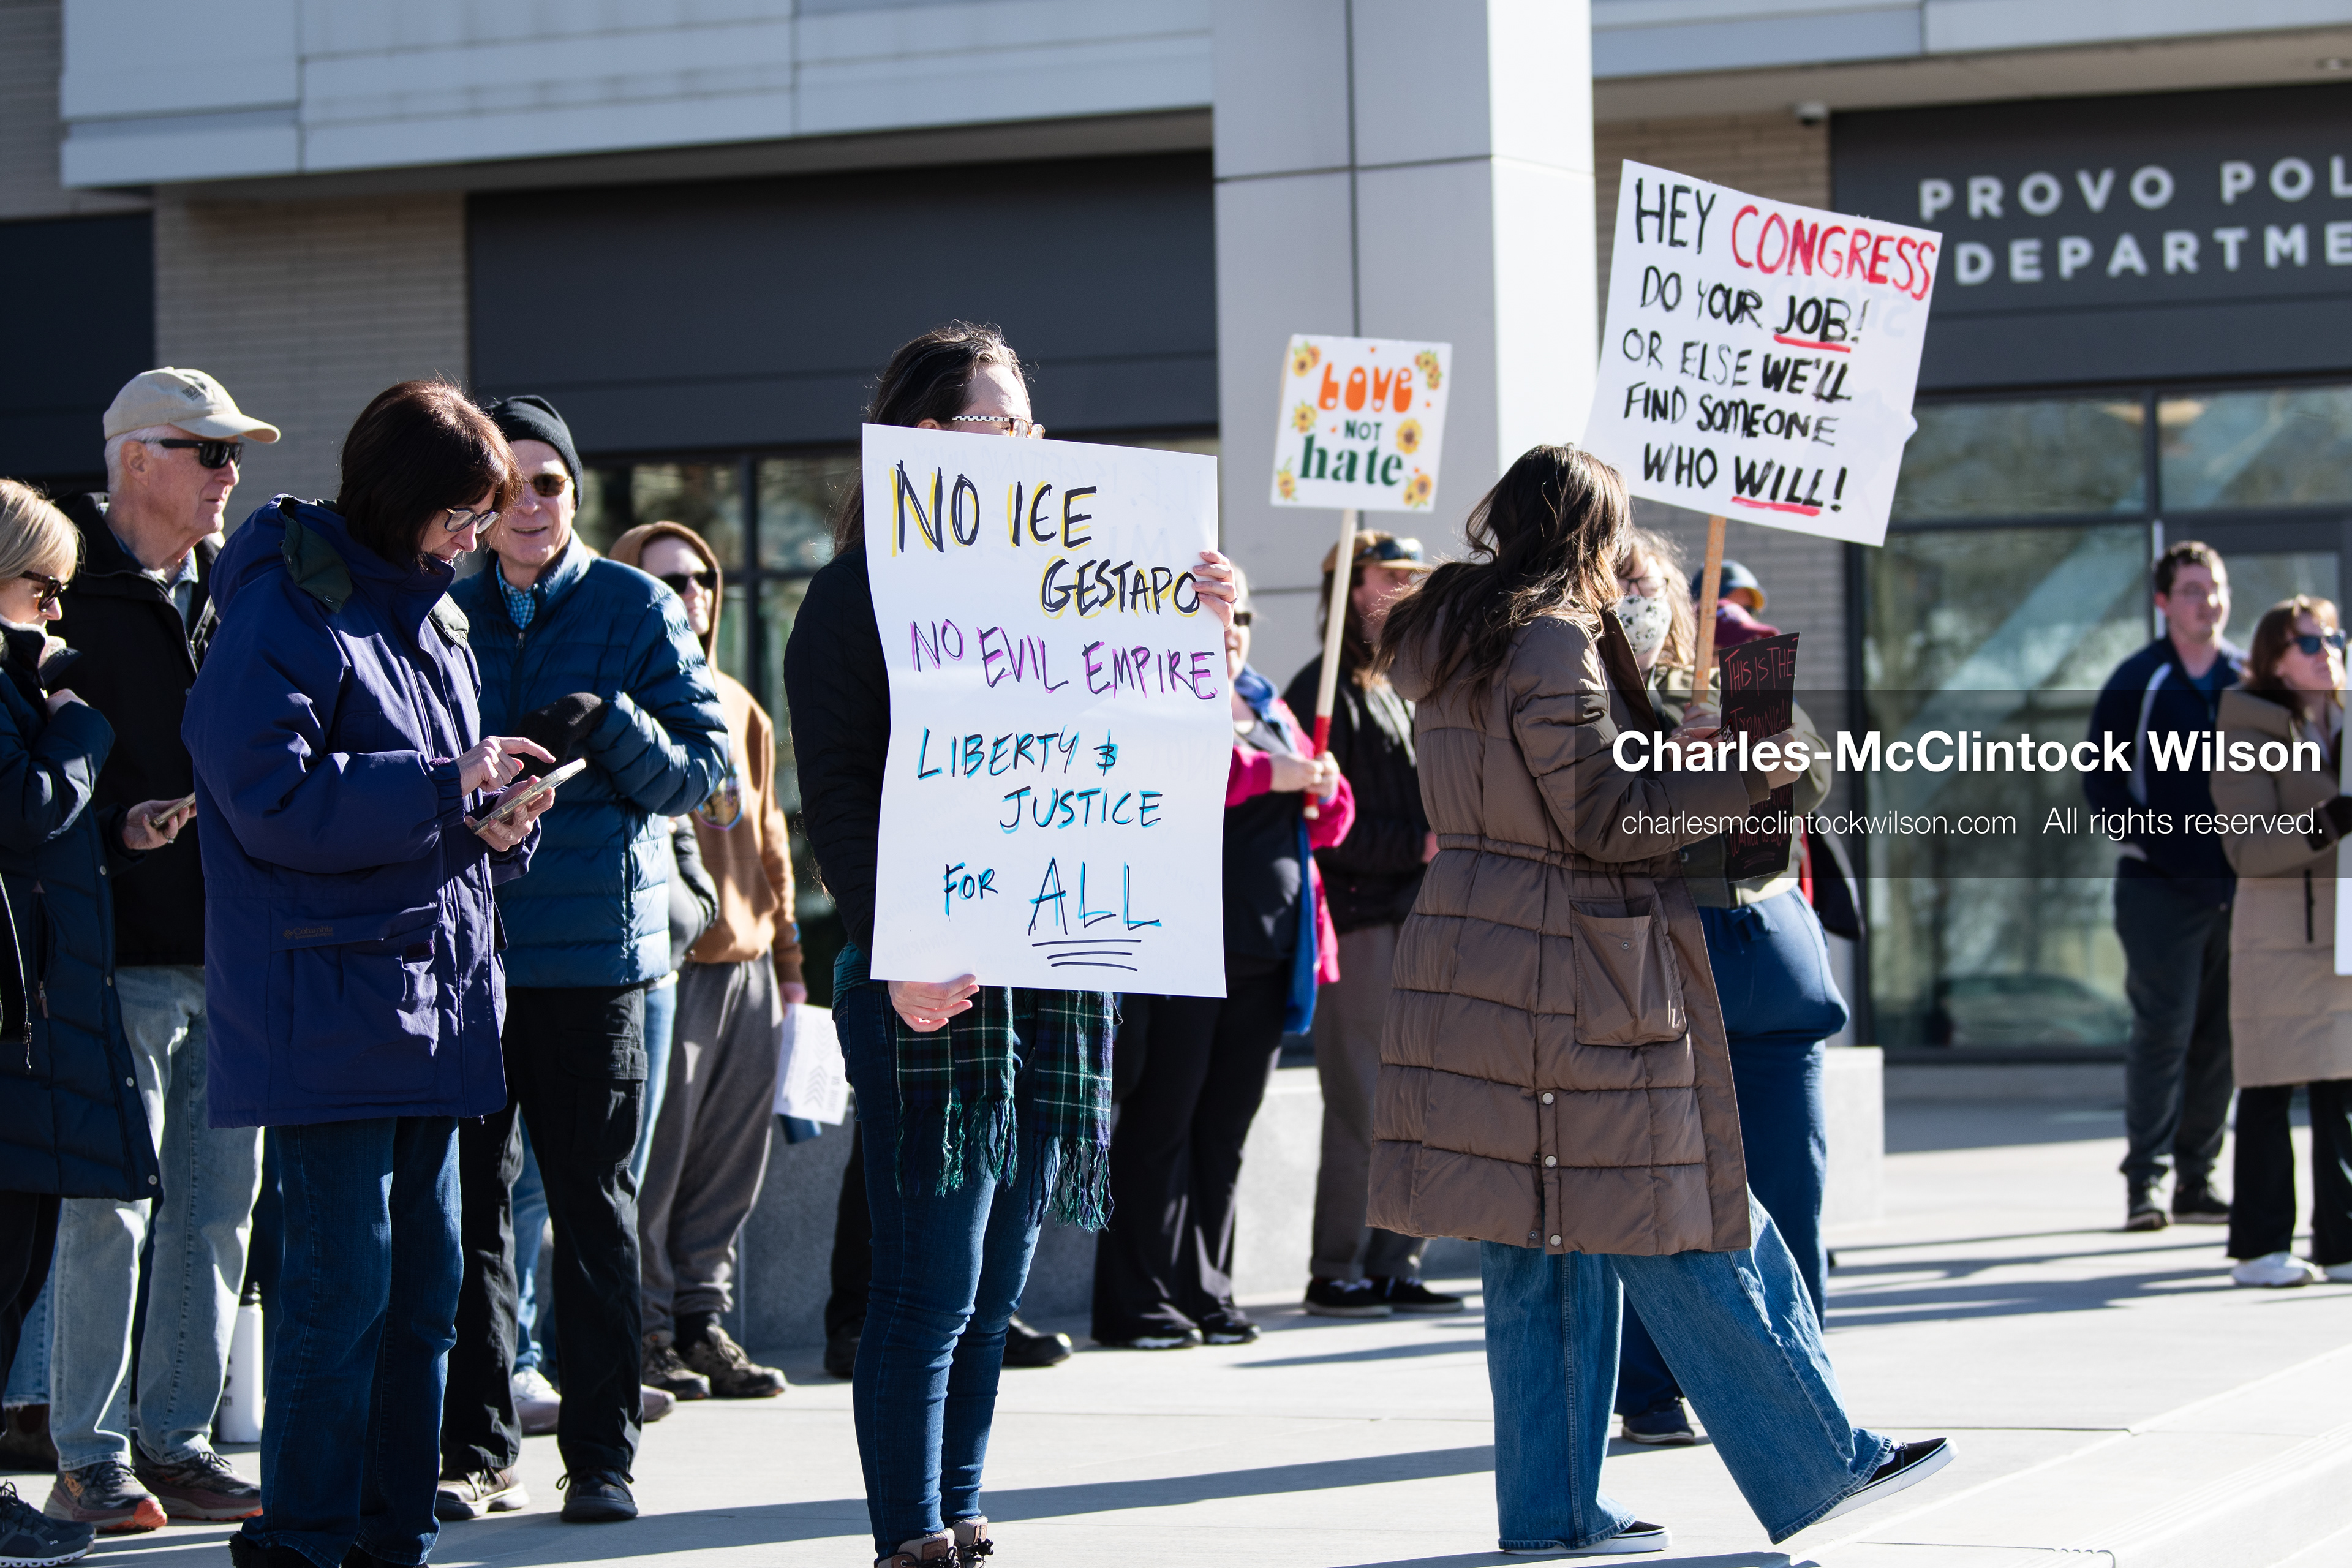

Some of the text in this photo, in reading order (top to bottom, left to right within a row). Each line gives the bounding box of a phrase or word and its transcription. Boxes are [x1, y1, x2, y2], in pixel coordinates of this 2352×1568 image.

[1918, 154, 2352, 223] PROVO POL
[1635, 178, 1716, 255] HEY
[1732, 205, 1936, 301] CONGRESS
[1954, 222, 2352, 286] DEPARTME
[1640, 266, 1871, 344] DO YOUR JOB!
[1623, 328, 1852, 402] OR ELSE WE'LL
[1344, 419, 1382, 441] NOT
[1624, 382, 1840, 447] FIND SOMEONE
[1299, 433, 1403, 486] hate
[1643, 442, 1848, 512] WHO WILL!
[889, 460, 980, 557] NO
[1007, 481, 1097, 551] ICE
[1041, 555, 1201, 619] GESTAPO
[910, 619, 1218, 700] NO EVIL EMPIRE
[1725, 647, 1796, 698] THIS IS THE
[917, 725, 1080, 781] LIBERTY
[999, 786, 1163, 834] JUSTICE
[943, 862, 998, 922] FOR
[1028, 856, 1163, 936] ALL
[293, 926, 333, 935] Columbia
